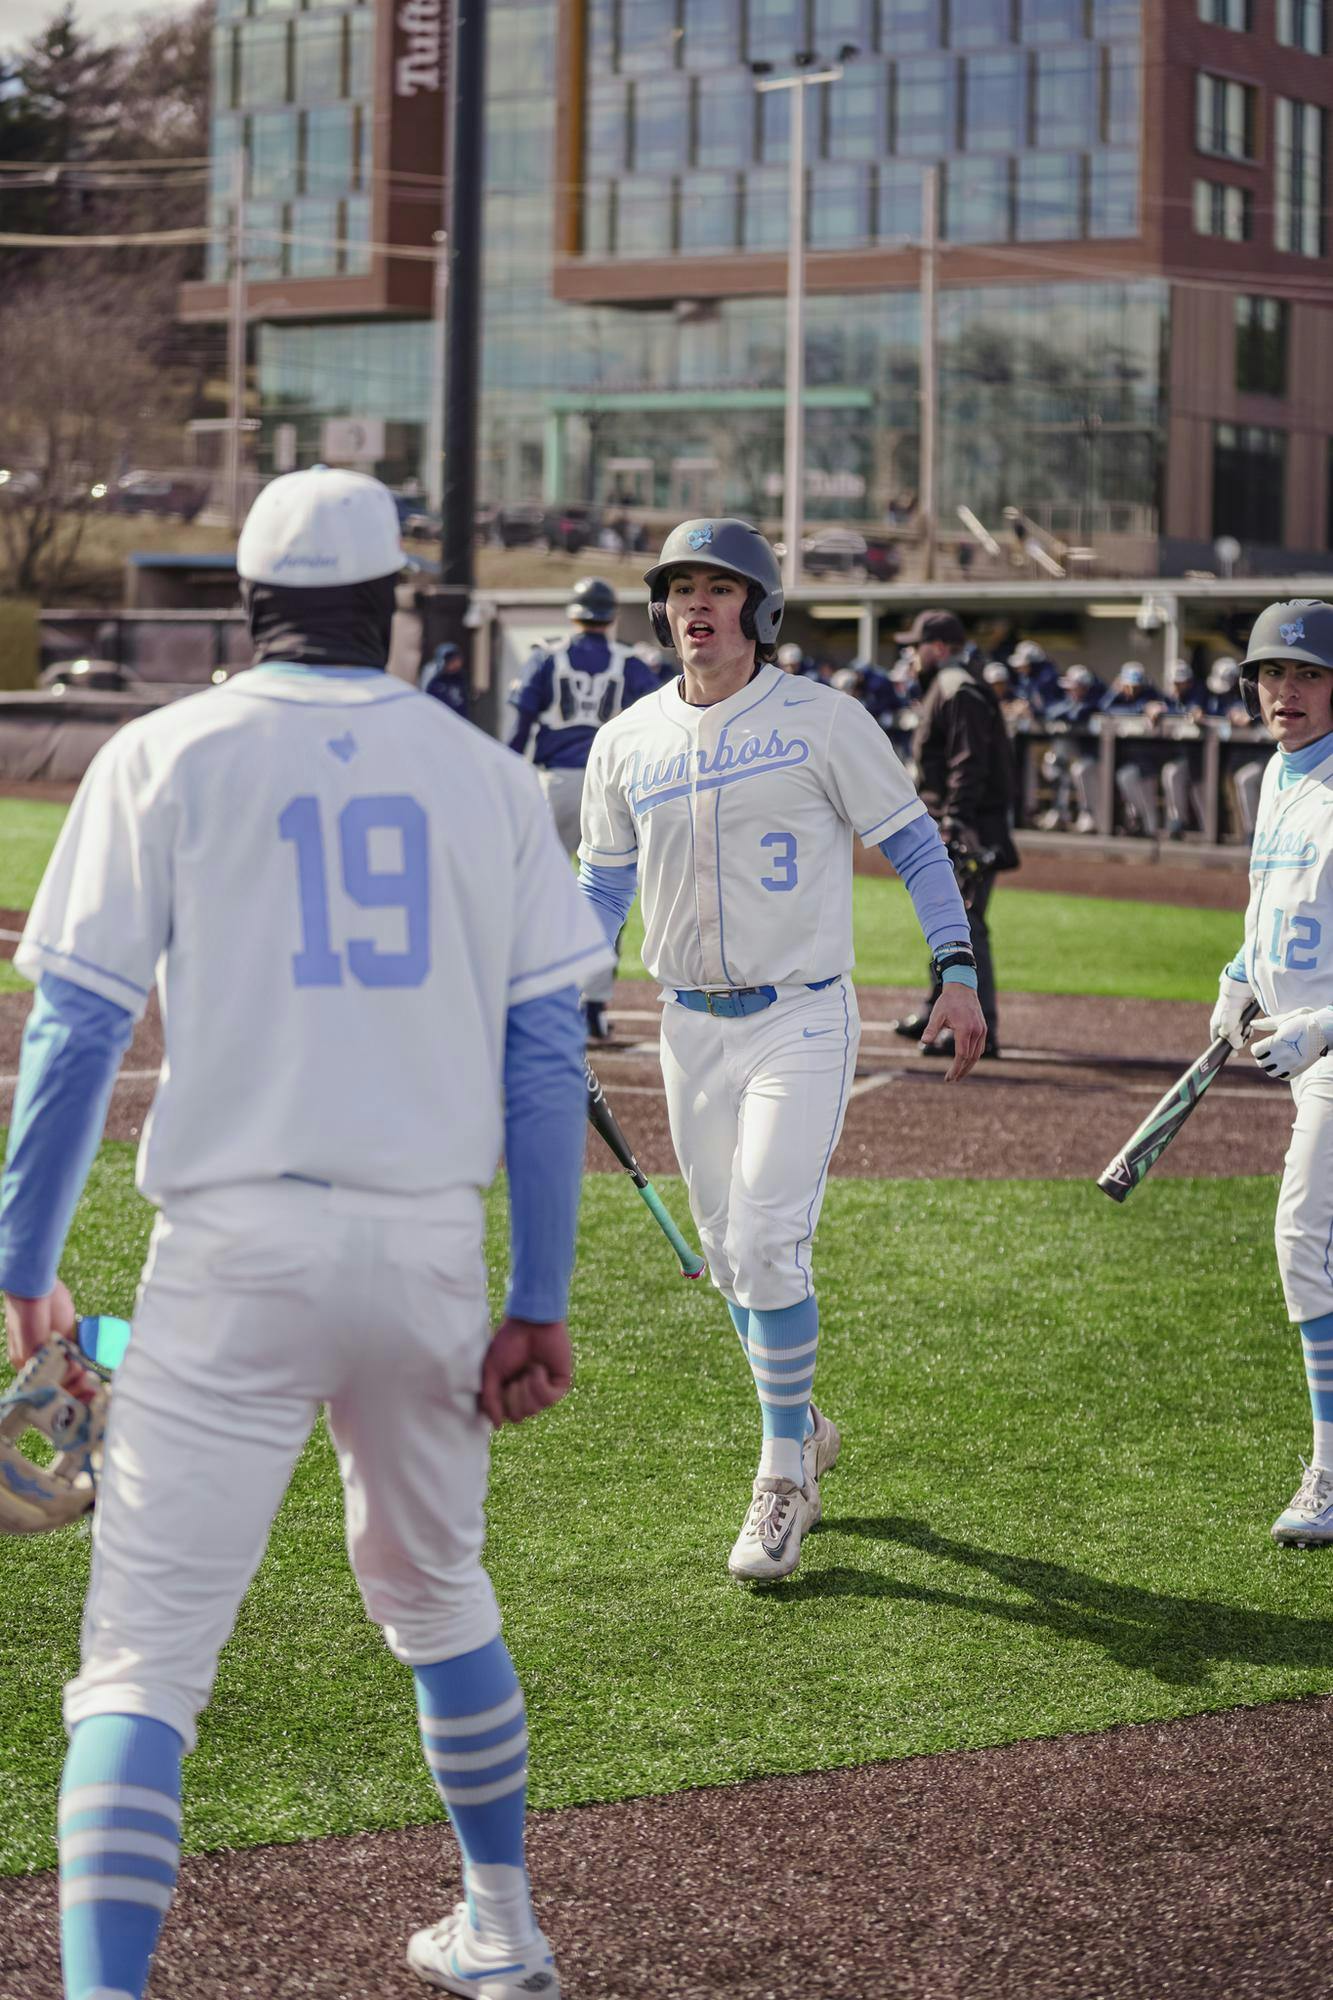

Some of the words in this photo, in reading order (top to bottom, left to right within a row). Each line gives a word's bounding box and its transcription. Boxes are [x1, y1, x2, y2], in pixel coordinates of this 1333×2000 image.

[396, 0, 440, 96] Tuft
[624, 728, 809, 817] Jumbos
[279, 795, 430, 988] 19
[760, 832, 798, 891] 3
[1269, 908, 1321, 970] 12
